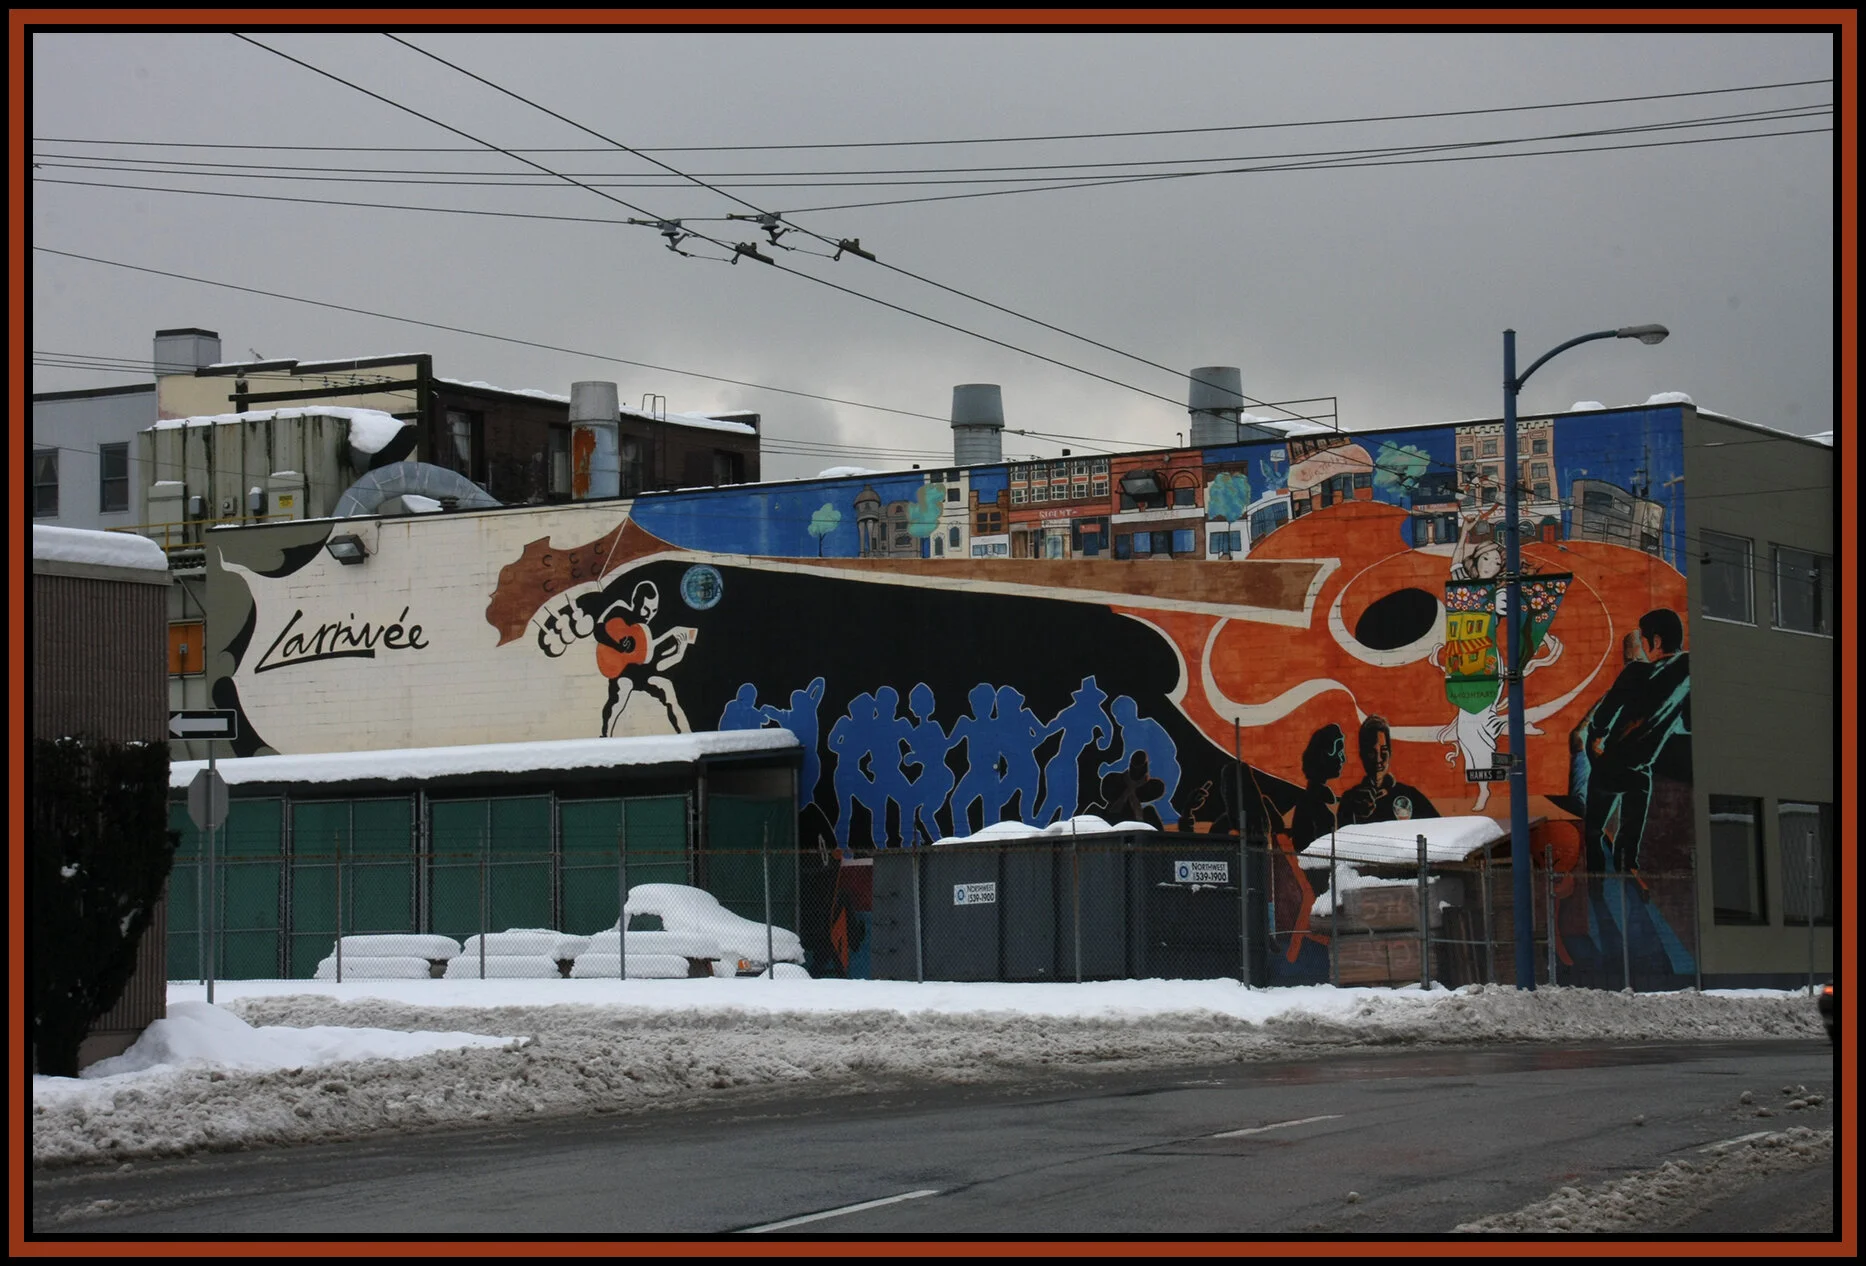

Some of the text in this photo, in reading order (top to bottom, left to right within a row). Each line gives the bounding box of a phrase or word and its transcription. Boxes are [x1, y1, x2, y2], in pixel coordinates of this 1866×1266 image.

[254, 606, 429, 674] Larrivée
[1469, 770, 1493, 780] HAWKS
[1191, 862, 1226, 871] NORTHWEST
